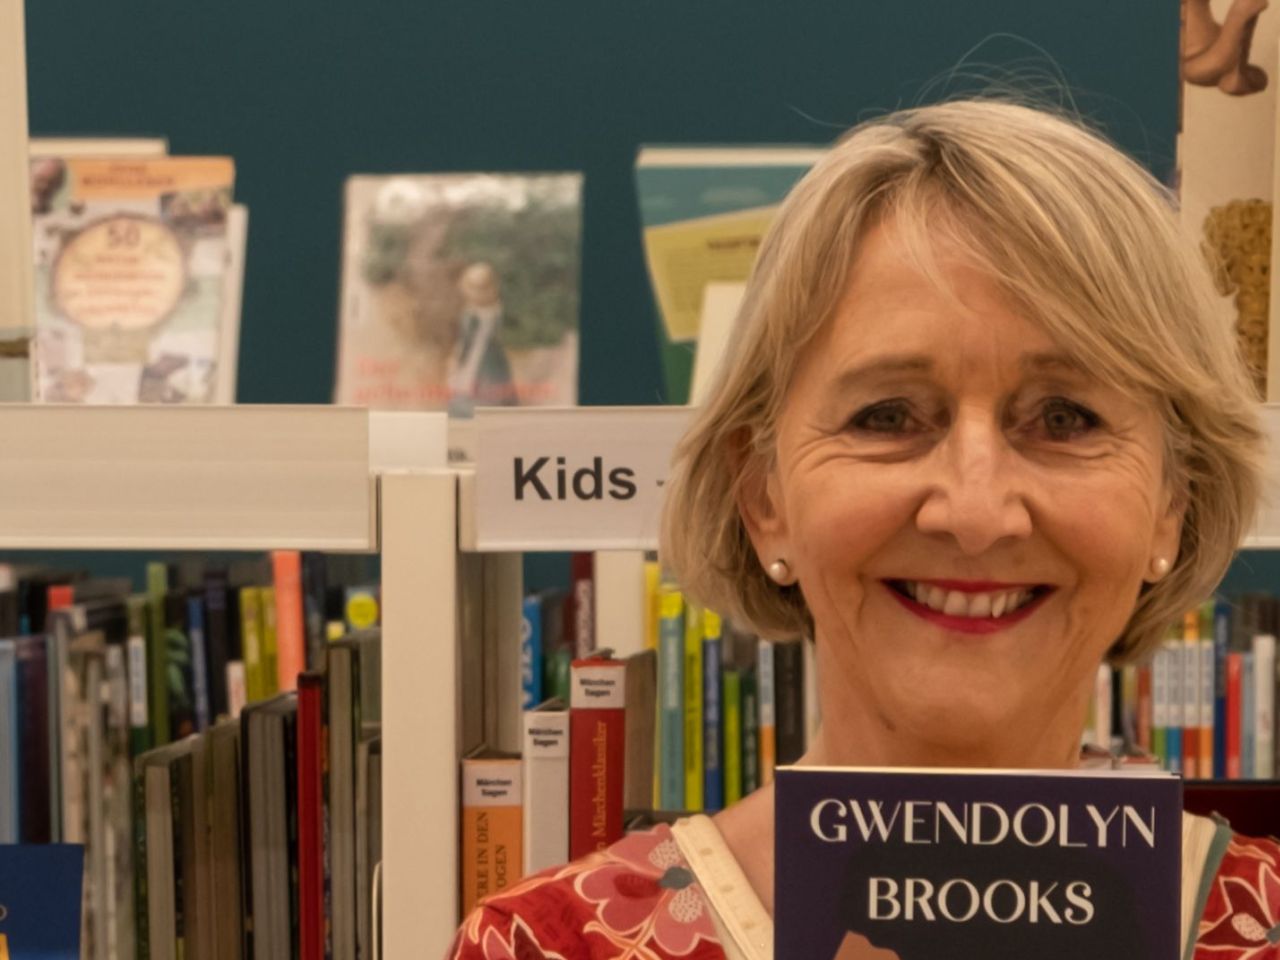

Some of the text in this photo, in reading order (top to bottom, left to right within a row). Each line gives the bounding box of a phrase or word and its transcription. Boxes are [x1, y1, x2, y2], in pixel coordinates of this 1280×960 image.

[514, 456, 637, 500] Kids
[475, 811, 489, 843] DEN
[809, 798, 1156, 849] GWENDOLYN
[475, 847, 489, 866] IN
[867, 876, 1096, 926] BROOKS
